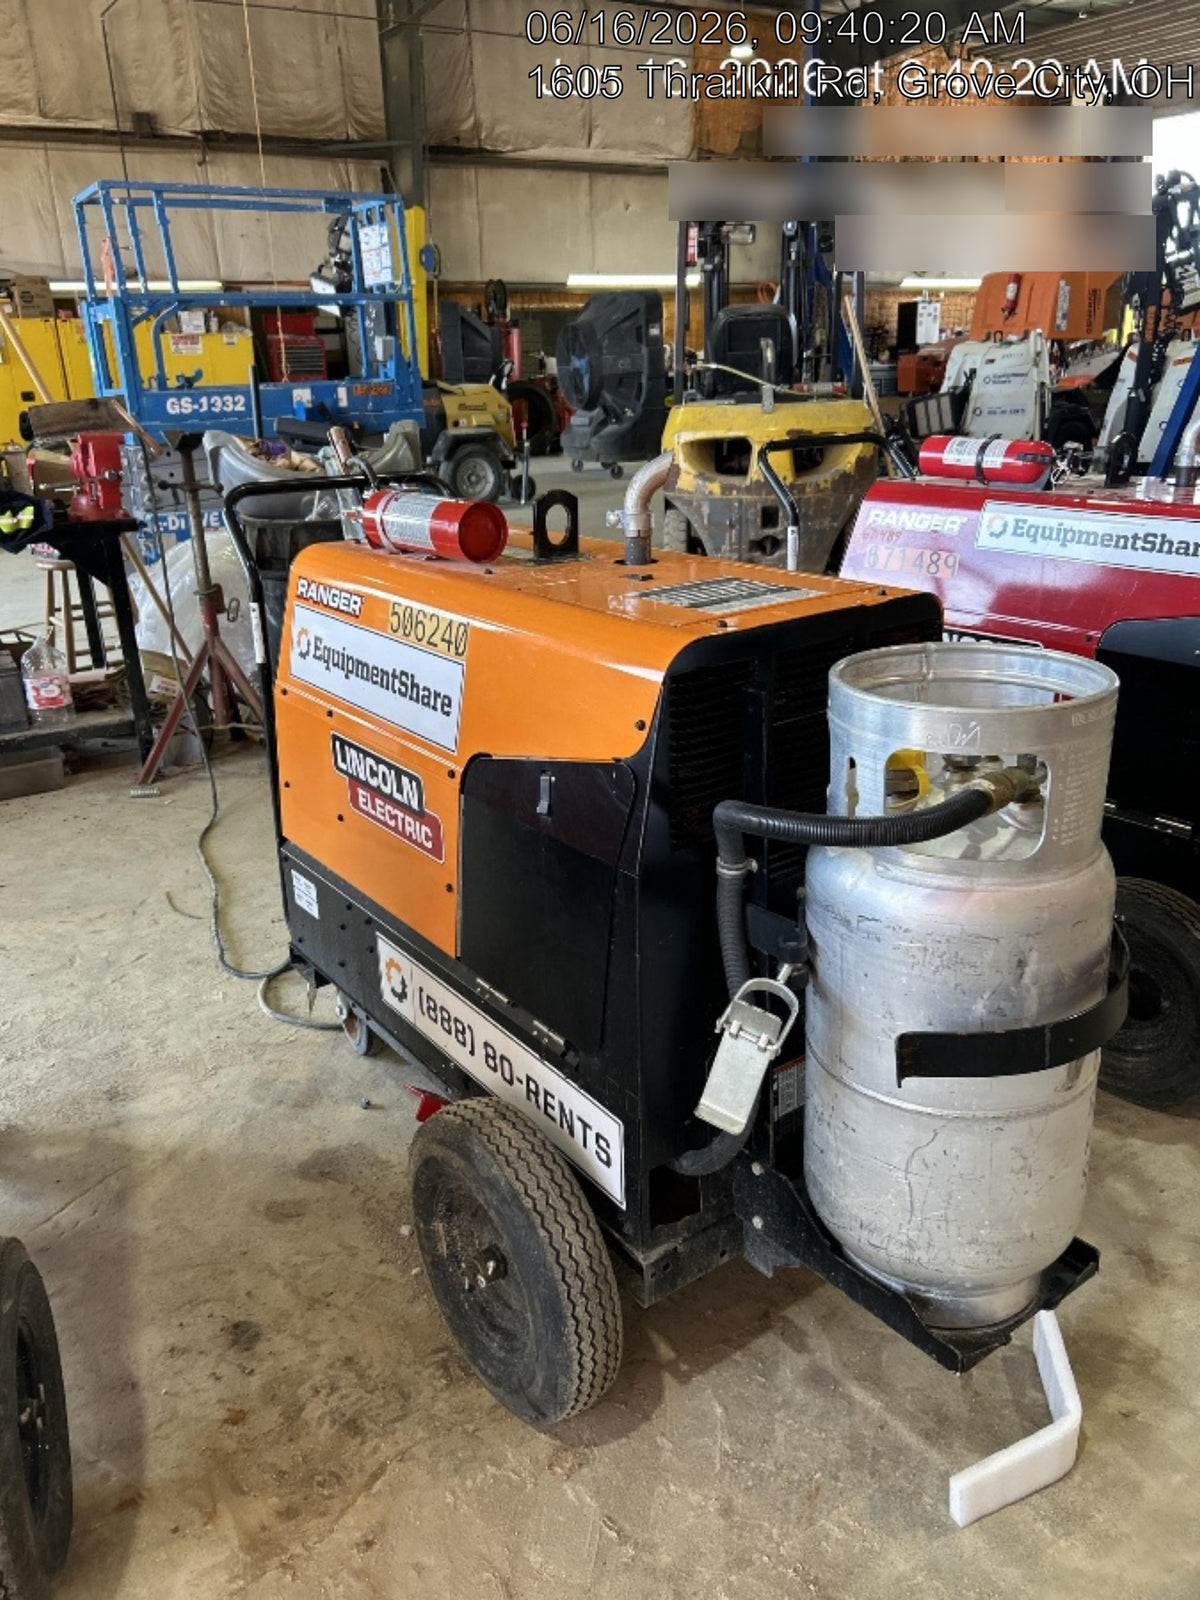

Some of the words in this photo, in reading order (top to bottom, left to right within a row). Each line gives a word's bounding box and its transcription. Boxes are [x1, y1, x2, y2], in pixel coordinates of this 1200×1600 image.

[166, 394, 246, 415] GS-1932
[867, 508, 963, 533] RANGER
[296, 577, 362, 617] RANGER
[390, 602, 468, 657] 506240
[313, 634, 452, 717] EquipmentShare
[335, 740, 420, 811] LINCOLN
[357, 787, 433, 849] ELECTRIC
[418, 985, 476, 1057] (888)
[483, 1040, 613, 1169] 80-RENTS
